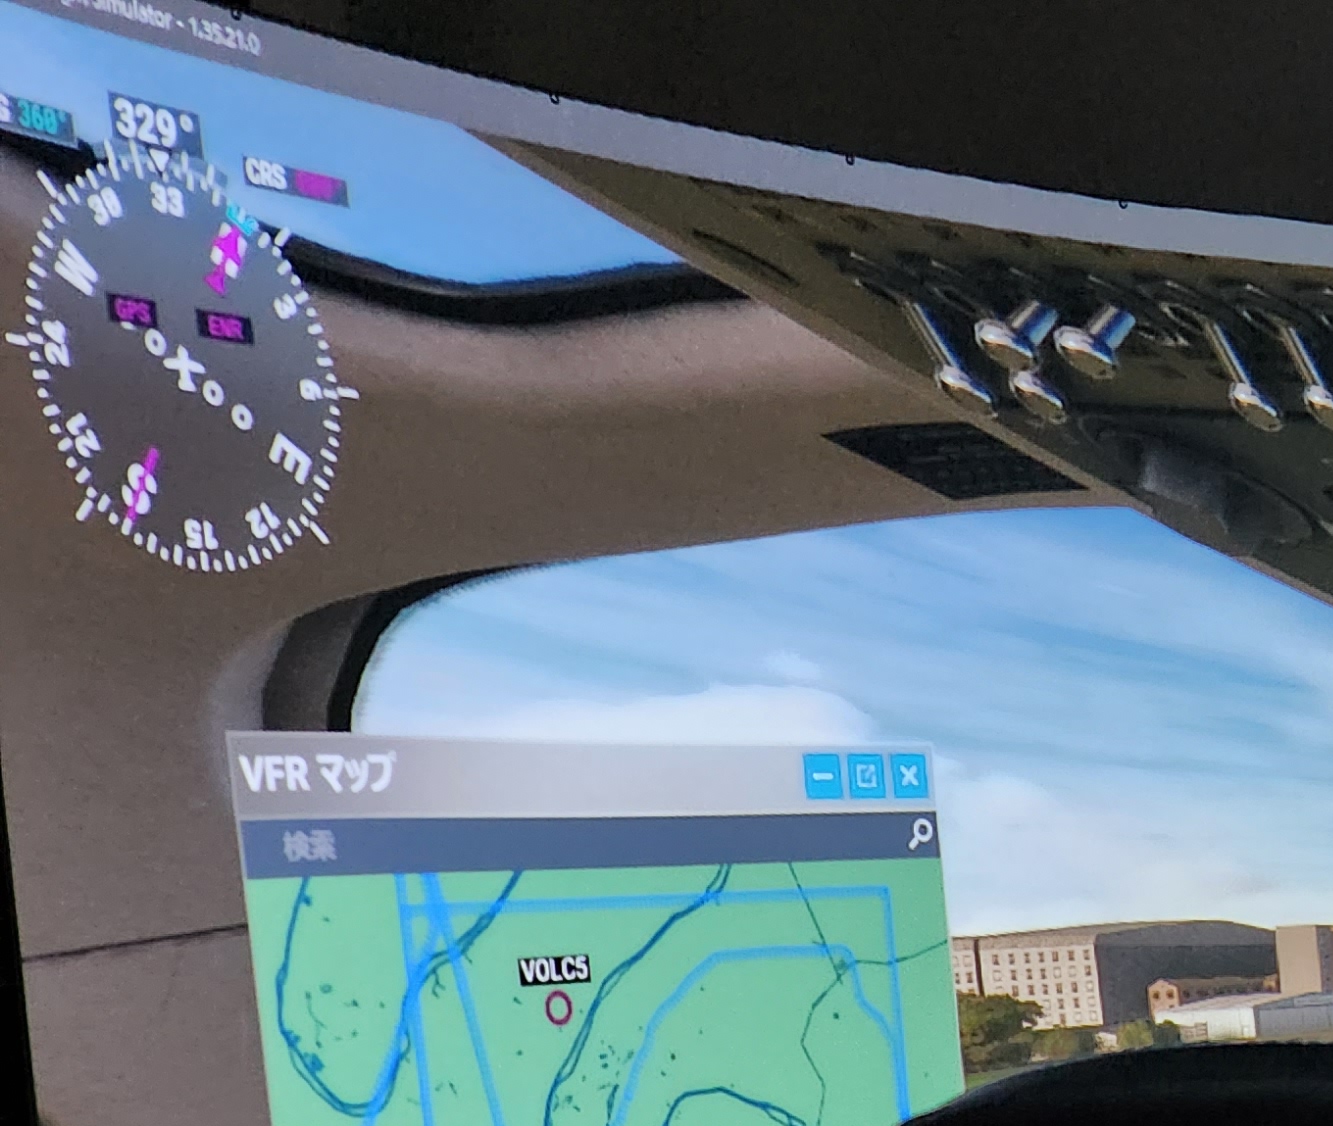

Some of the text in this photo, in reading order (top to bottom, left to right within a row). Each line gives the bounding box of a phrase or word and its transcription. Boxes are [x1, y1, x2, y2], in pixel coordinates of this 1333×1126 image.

[113, 97, 194, 148] 329°
[245, 156, 287, 190] CRS
[87, 187, 123, 226] 30
[150, 182, 186, 218] 33
[54, 238, 98, 297] W
[268, 432, 313, 485] E
[239, 750, 397, 794] VFR マップ
[282, 829, 338, 863] 検索
[519, 954, 588, 983] VOLC5
